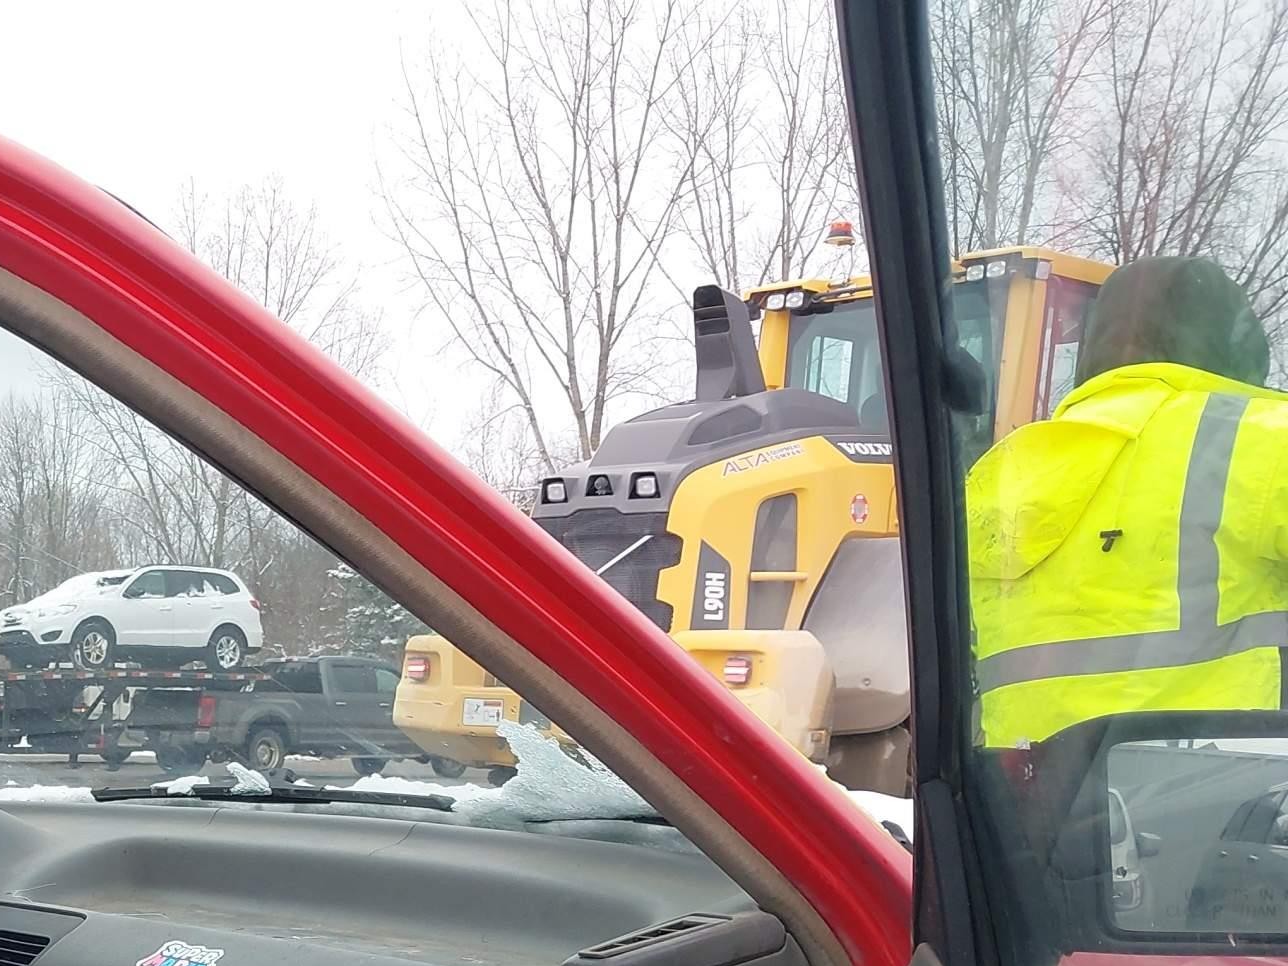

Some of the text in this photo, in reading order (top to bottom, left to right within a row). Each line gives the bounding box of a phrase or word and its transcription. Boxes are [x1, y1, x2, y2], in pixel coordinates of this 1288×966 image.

[836, 442, 892, 456] VOLV
[722, 450, 769, 477] ALTA
[703, 572, 725, 621] L90H
[161, 943, 220, 966] SUPER
